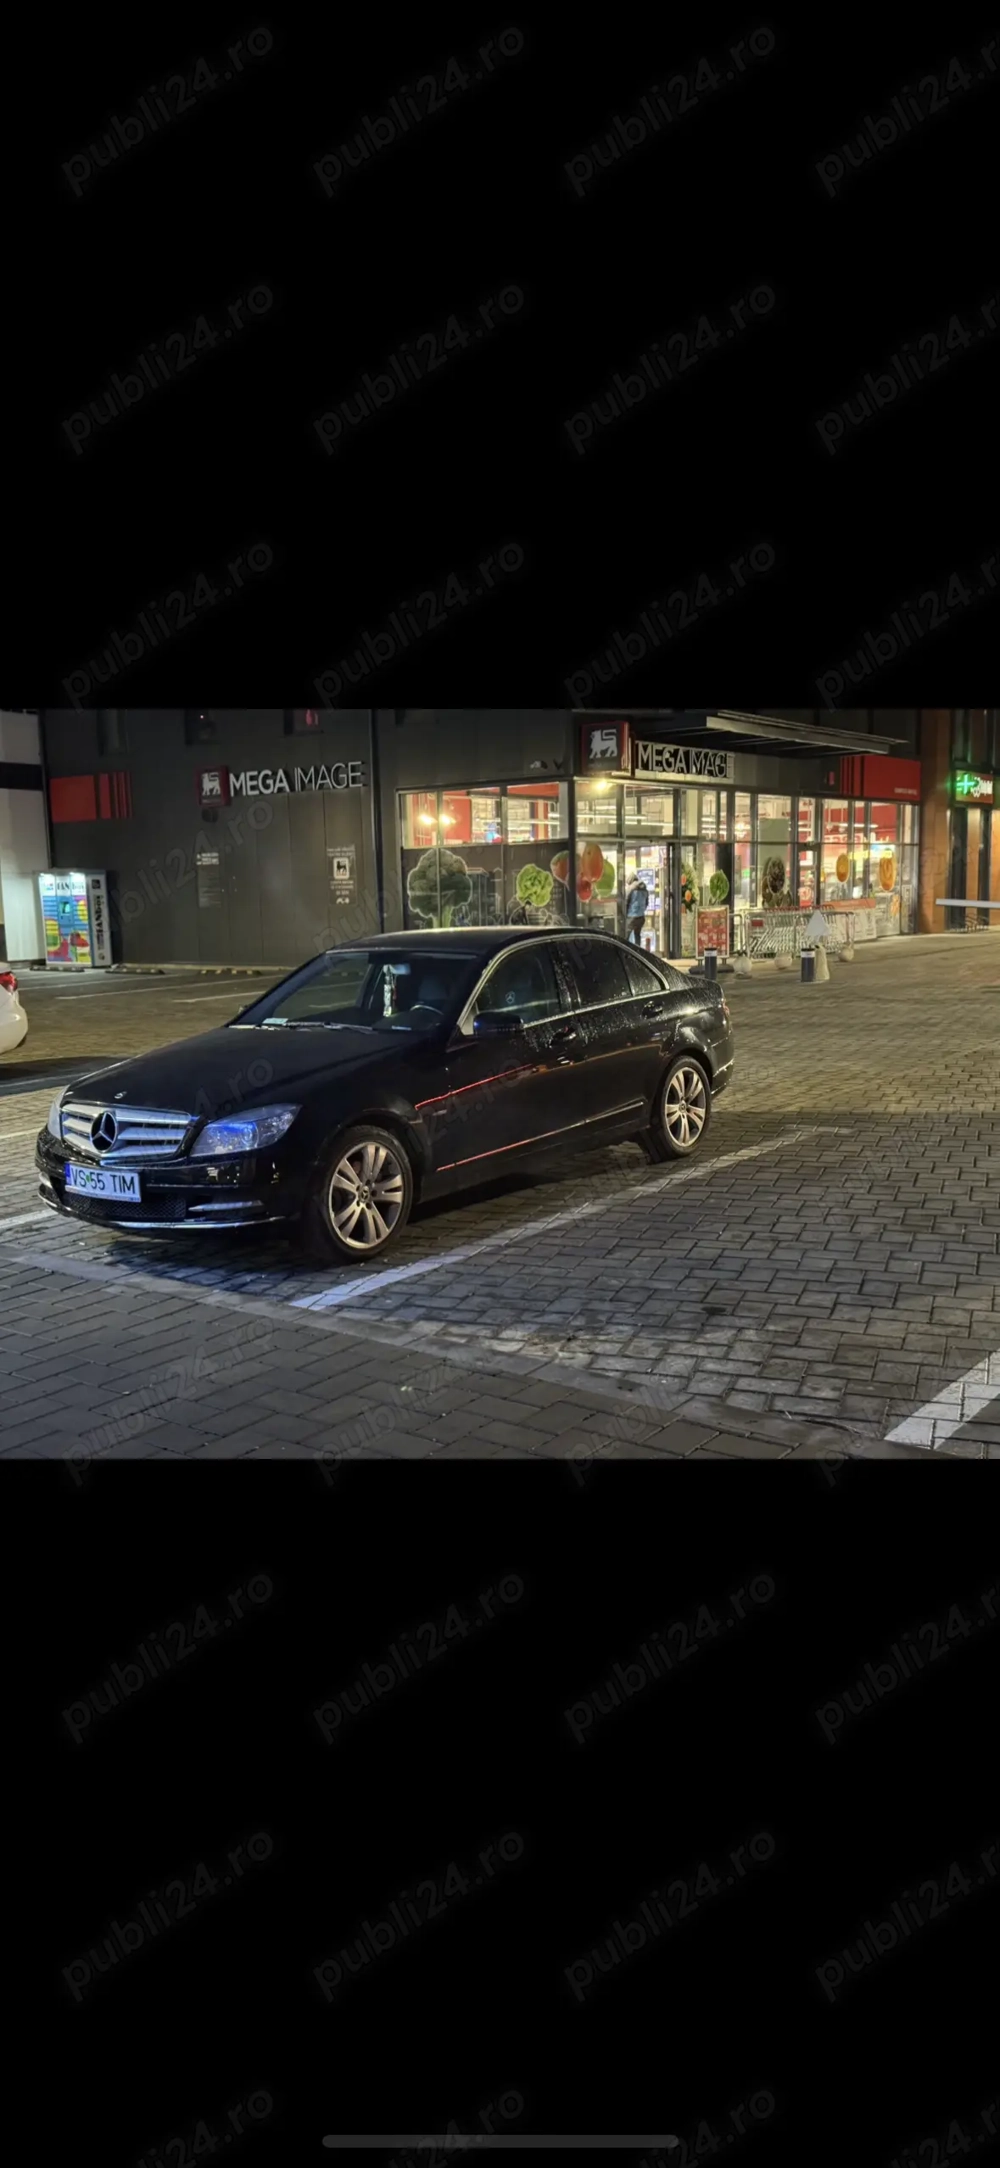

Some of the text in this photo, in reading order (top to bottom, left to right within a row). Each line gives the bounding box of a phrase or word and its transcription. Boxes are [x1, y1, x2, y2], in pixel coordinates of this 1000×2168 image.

[638, 742, 687, 773] MEGA
[230, 760, 363, 797] MEGA IMAGE
[71, 1167, 87, 1187] VS
[90, 1172, 106, 1191] 55
[110, 1174, 136, 1194] TIM
